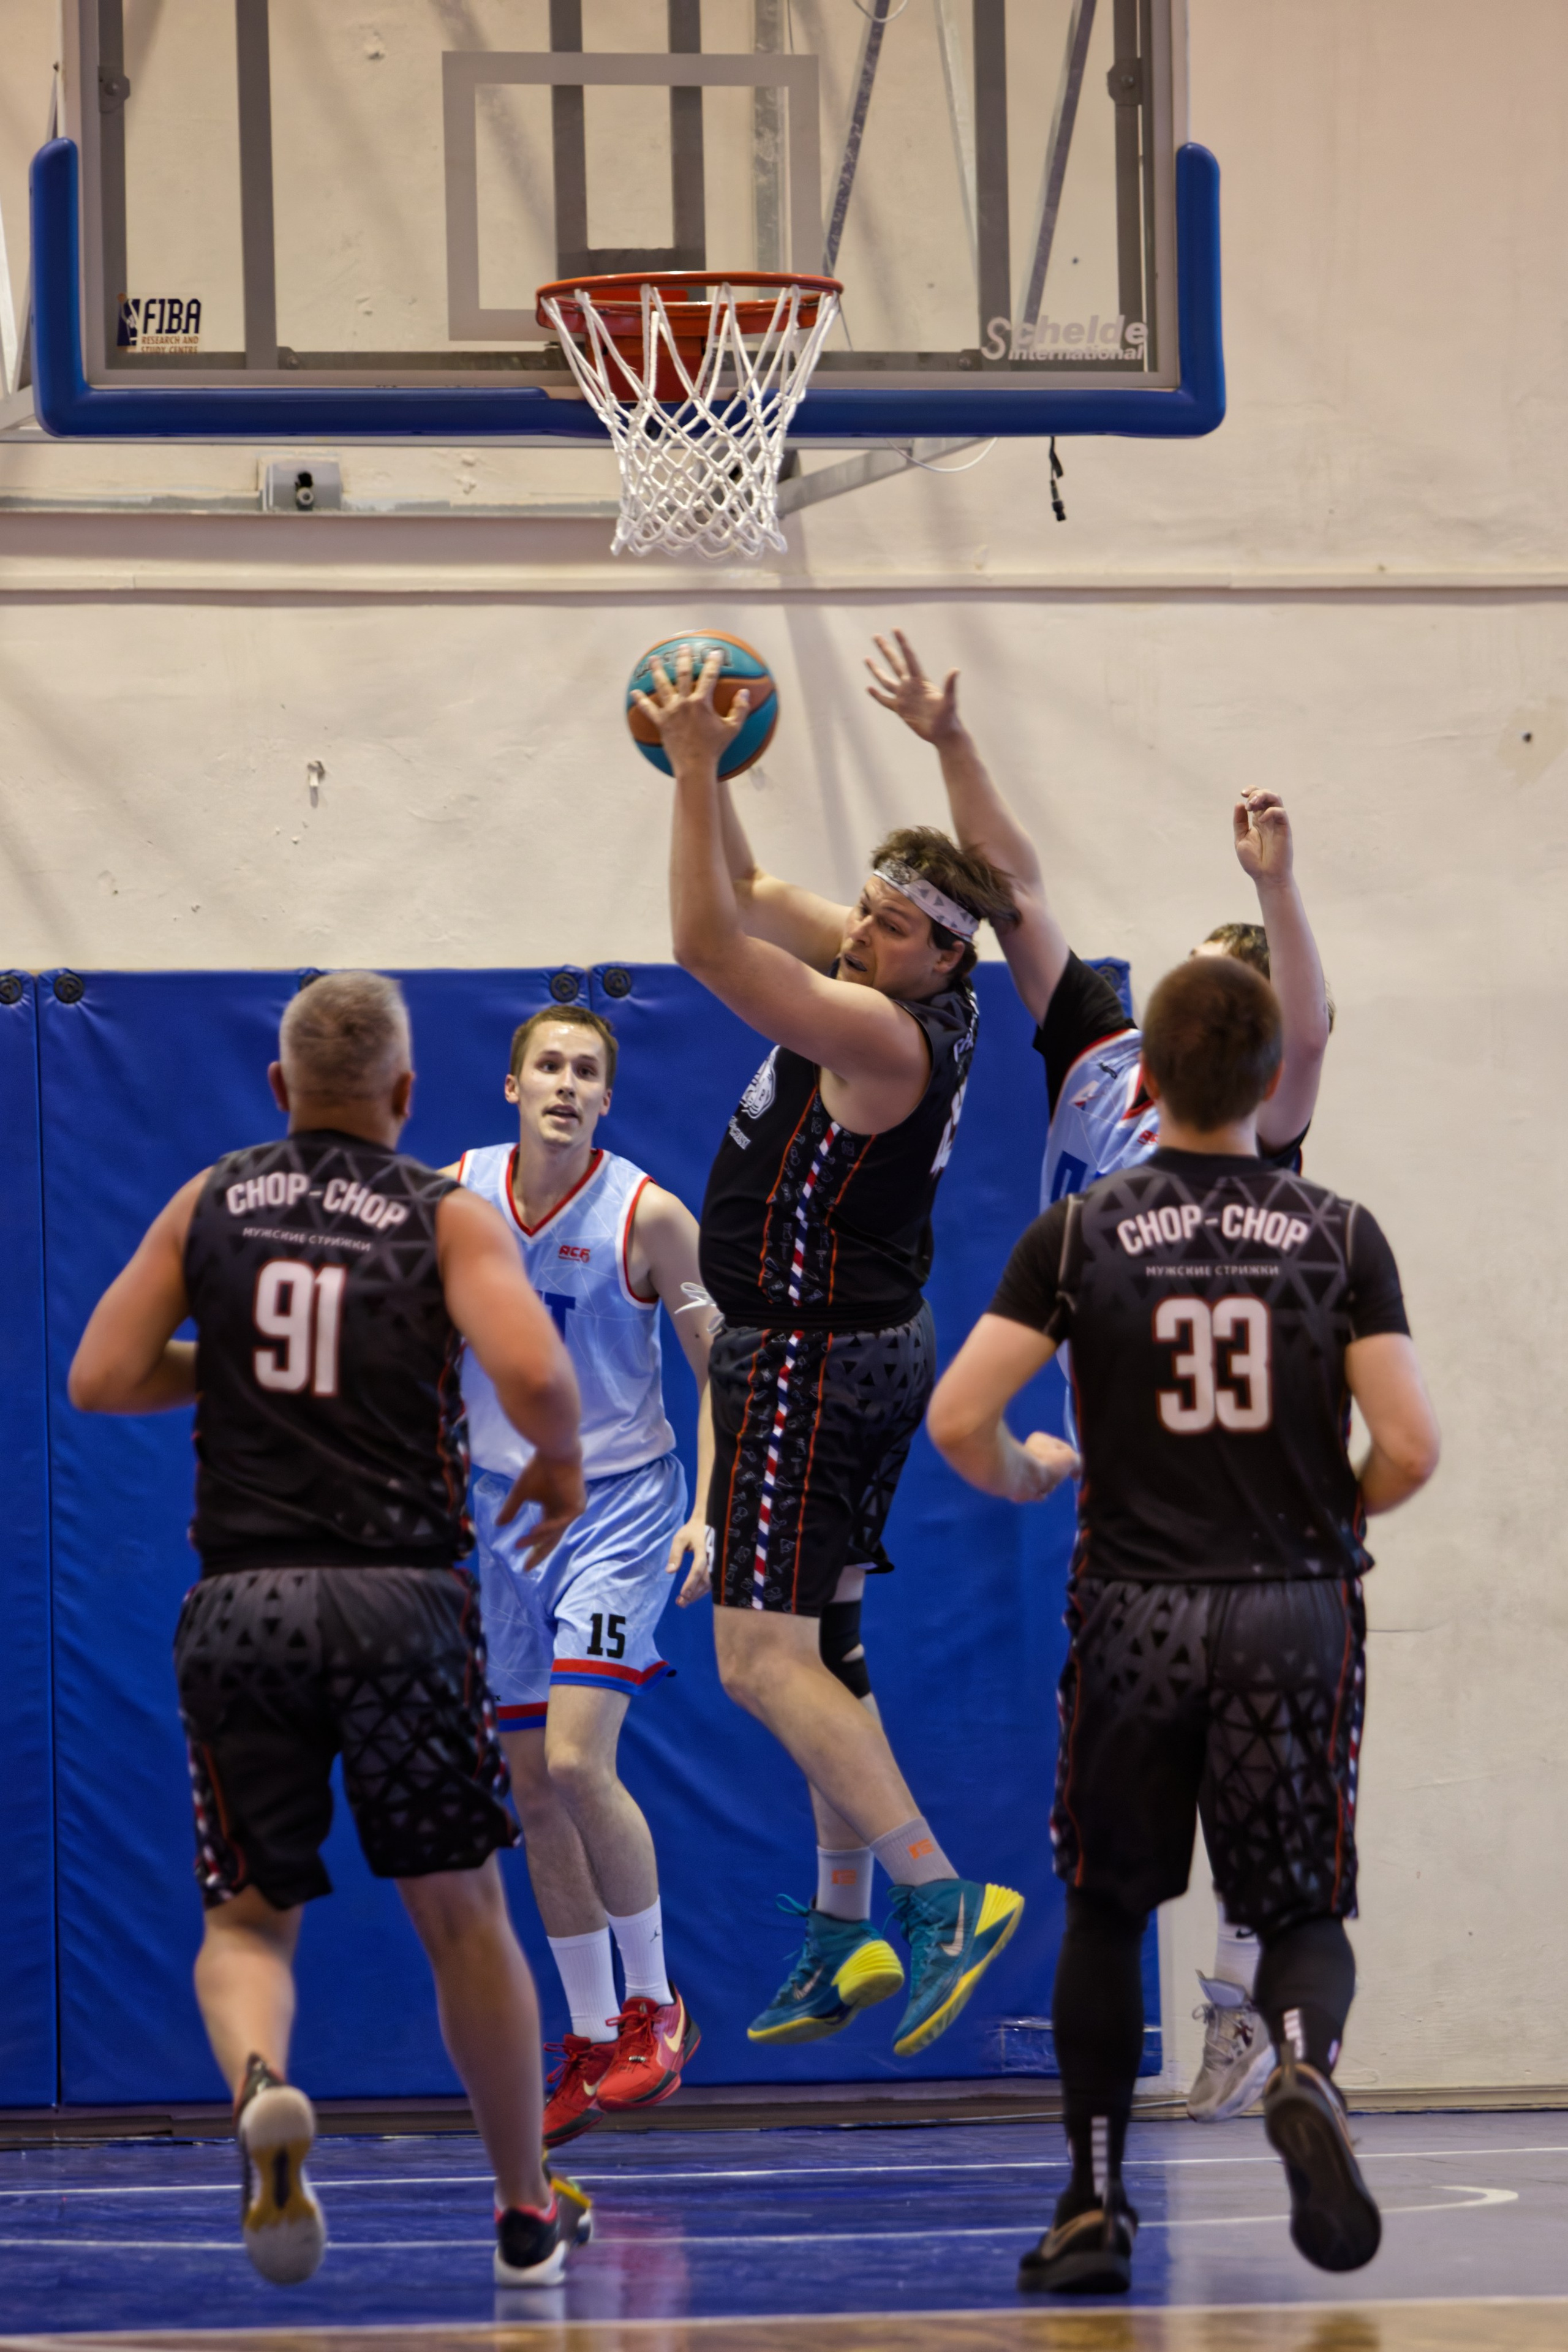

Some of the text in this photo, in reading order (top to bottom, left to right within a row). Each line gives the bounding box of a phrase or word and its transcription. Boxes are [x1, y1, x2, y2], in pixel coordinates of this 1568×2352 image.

[143, 298, 202, 334] FIBA
[981, 315, 1148, 360] Schelde
[225, 1172, 410, 1231] CHOP-CHOP
[243, 1227, 371, 1251] МУЖСКИЕ СТРИЖКИ
[1117, 1204, 1310, 1256] CHOP-CHOP
[1145, 1265, 1280, 1276] МУЖСКИЕ СТРИЖКИ
[252, 1257, 347, 1397] 91
[1152, 1294, 1272, 1434] 33
[587, 1613, 626, 1659] 15
